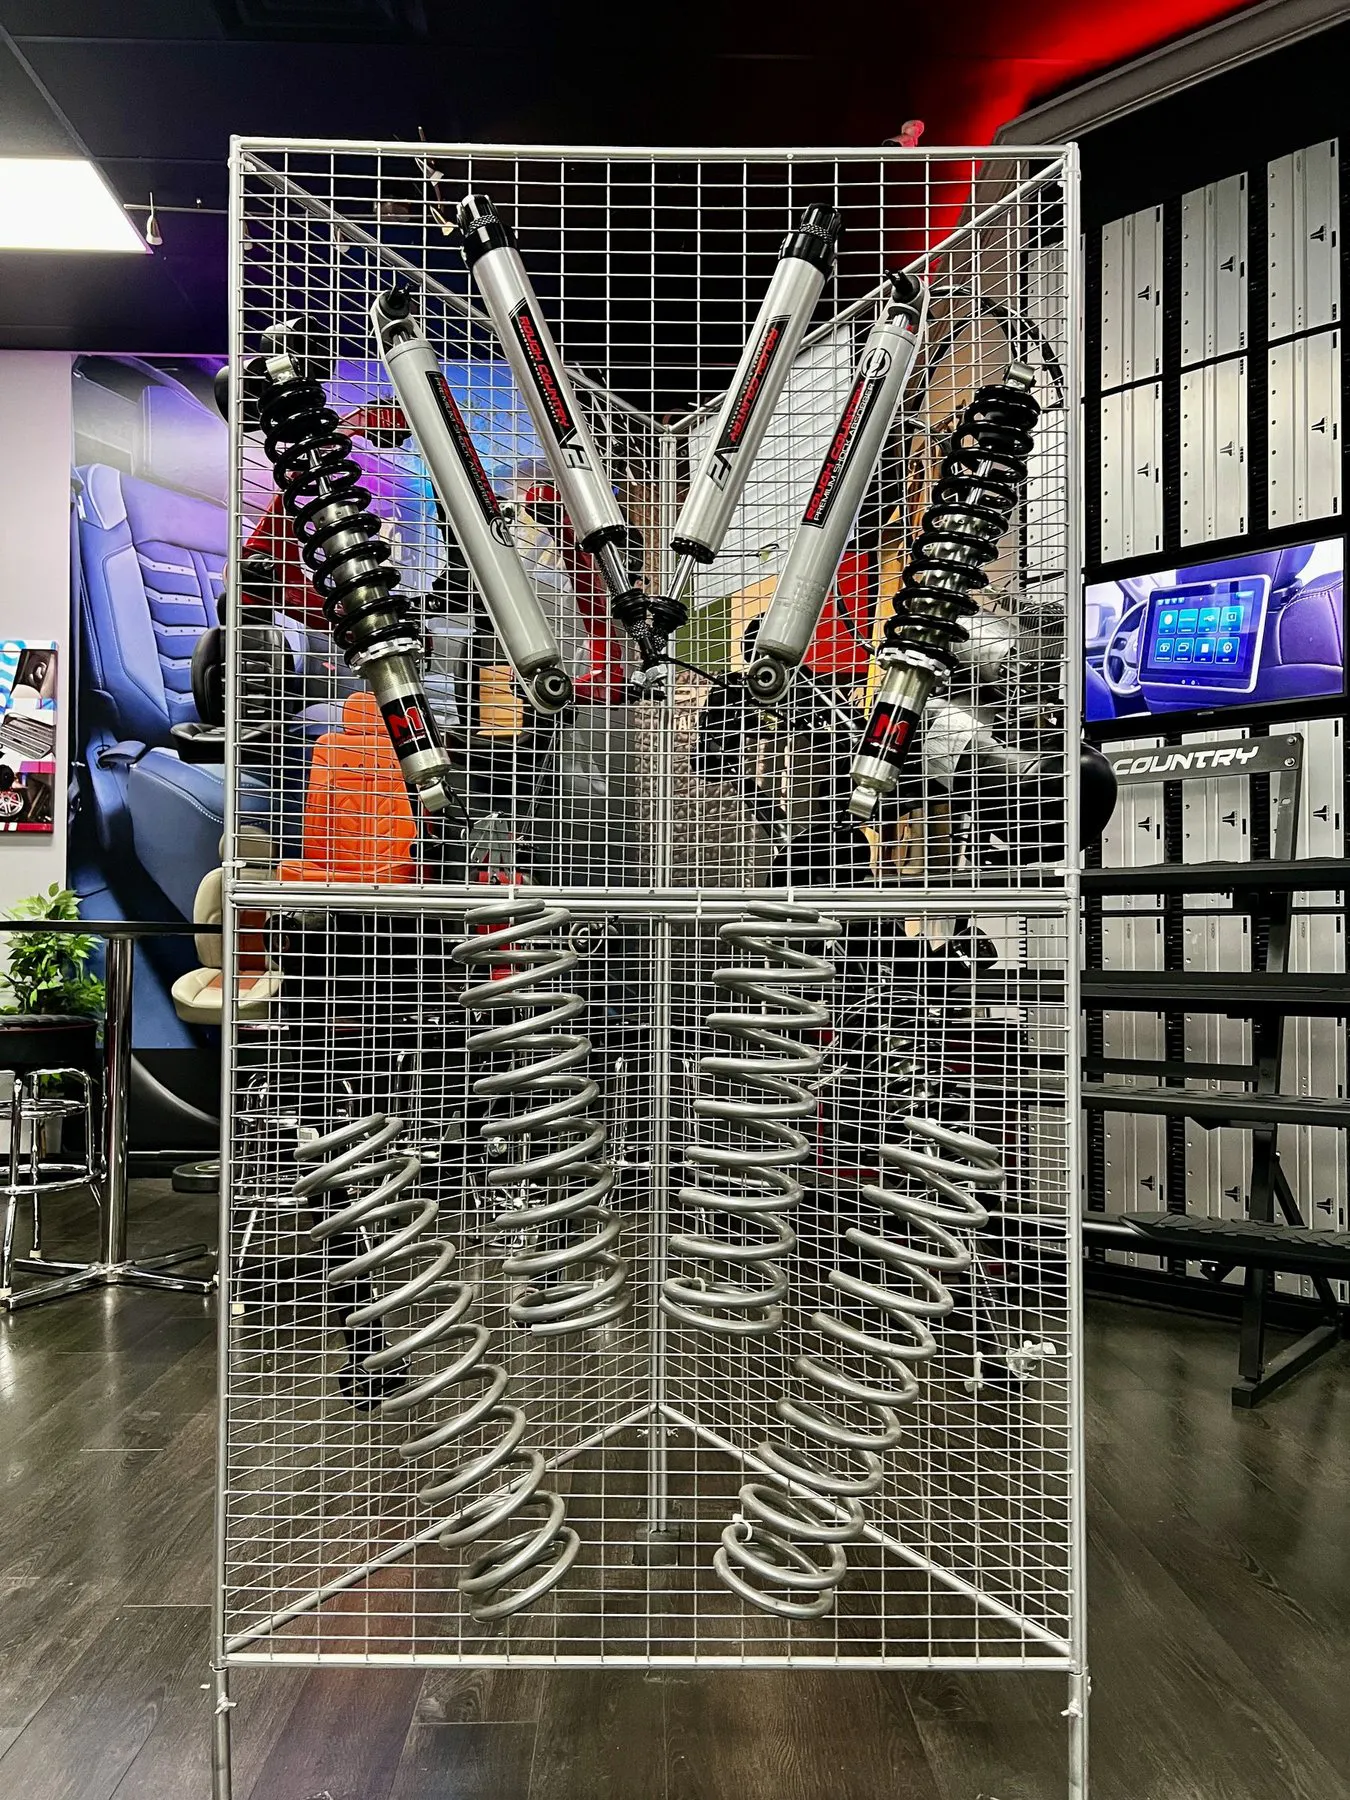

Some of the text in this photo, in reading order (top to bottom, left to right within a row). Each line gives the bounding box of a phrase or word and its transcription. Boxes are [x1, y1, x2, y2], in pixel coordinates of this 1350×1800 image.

[518, 316, 544, 361] ROUGH
[537, 364, 570, 427] COUNTRY
[755, 327, 779, 375] ROUGH
[434, 377, 455, 424] PREMIUM
[453, 424, 471, 461] SHOCK
[730, 377, 759, 443] COUNTRY
[806, 463, 834, 520] ROUGH
[813, 475, 836, 521] PREMIUM
[833, 439, 850, 473] SHOCK
[1112, 746, 1259, 776] COUNTRY
